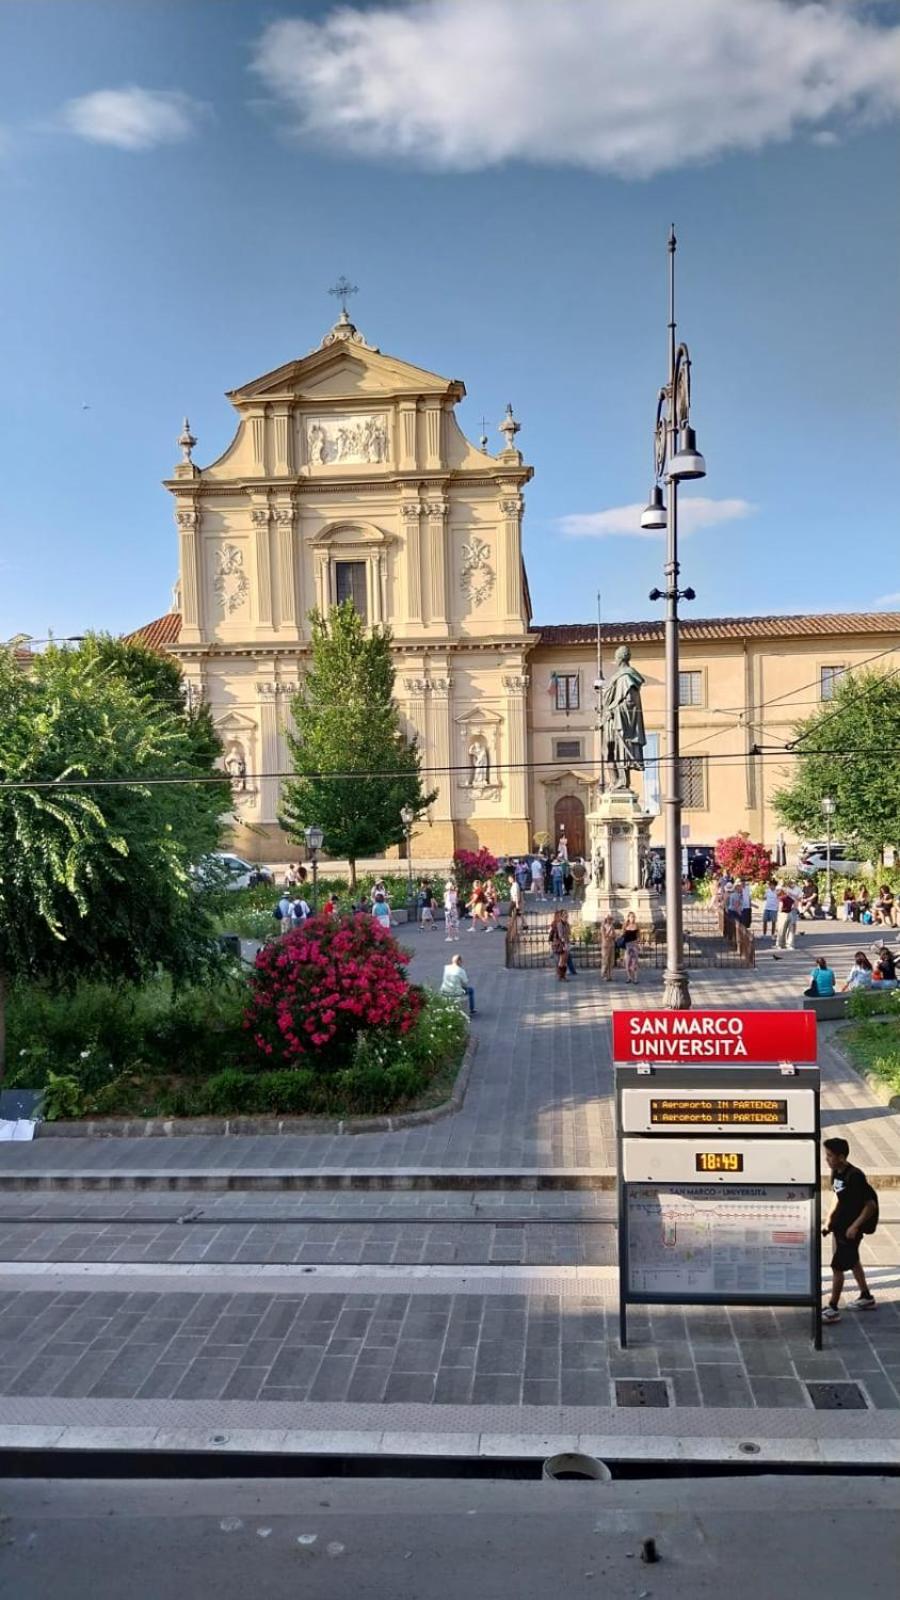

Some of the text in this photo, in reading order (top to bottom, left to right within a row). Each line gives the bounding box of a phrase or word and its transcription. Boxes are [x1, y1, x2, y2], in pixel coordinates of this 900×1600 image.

[630, 1018, 743, 1035] SAN MARCO
[631, 1036, 748, 1056] UNIVERSITÀ
[718, 1101, 729, 1109] IN
[733, 1101, 778, 1109] PARTENZA
[718, 1113, 729, 1121] IN
[733, 1113, 778, 1121] PARTENZA
[701, 1154, 737, 1169] 18:49
[687, 1188, 716, 1196] MARCO
